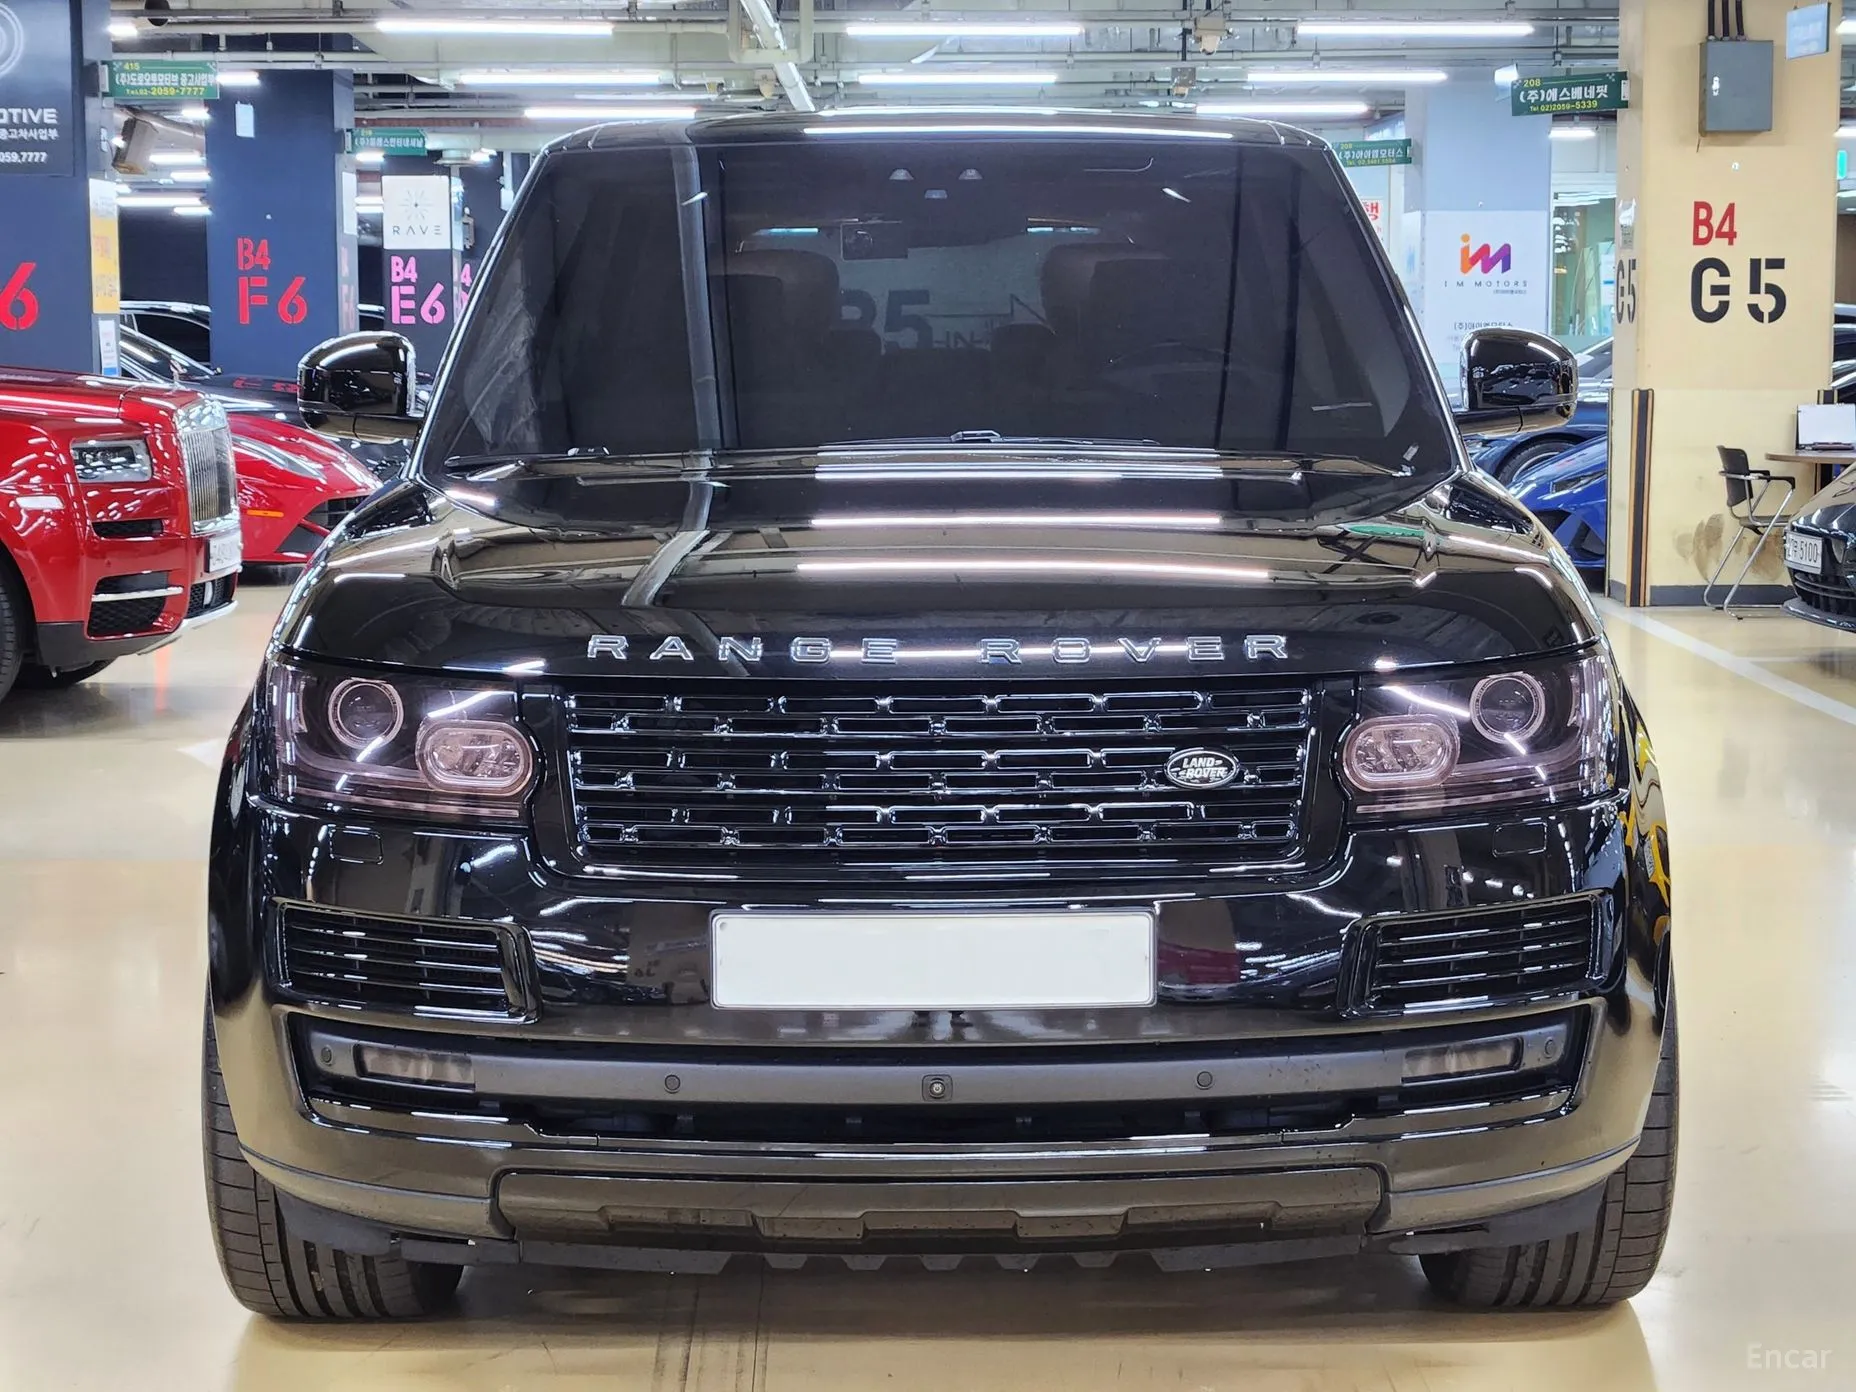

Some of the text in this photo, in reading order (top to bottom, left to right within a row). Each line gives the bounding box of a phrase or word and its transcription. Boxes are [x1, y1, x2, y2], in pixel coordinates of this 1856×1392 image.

[1519, 84, 1608, 103] (주)에스베네핏
[1523, 79, 1541, 87] 208
[392, 225, 443, 236] RAVE
[1692, 201, 1737, 246] B4
[237, 237, 271, 270] B4
[390, 255, 418, 283] B4
[0, 262, 39, 330] 6
[1475, 280, 1528, 288] MOTORS
[1616, 259, 1637, 324] G5
[391, 283, 446, 325] E6
[1799, 540, 1819, 564] 5100
[586, 633, 1289, 665] RANGE ROVER
[1183, 757, 1215, 769] LAND
[1186, 767, 1227, 779] ROVER
